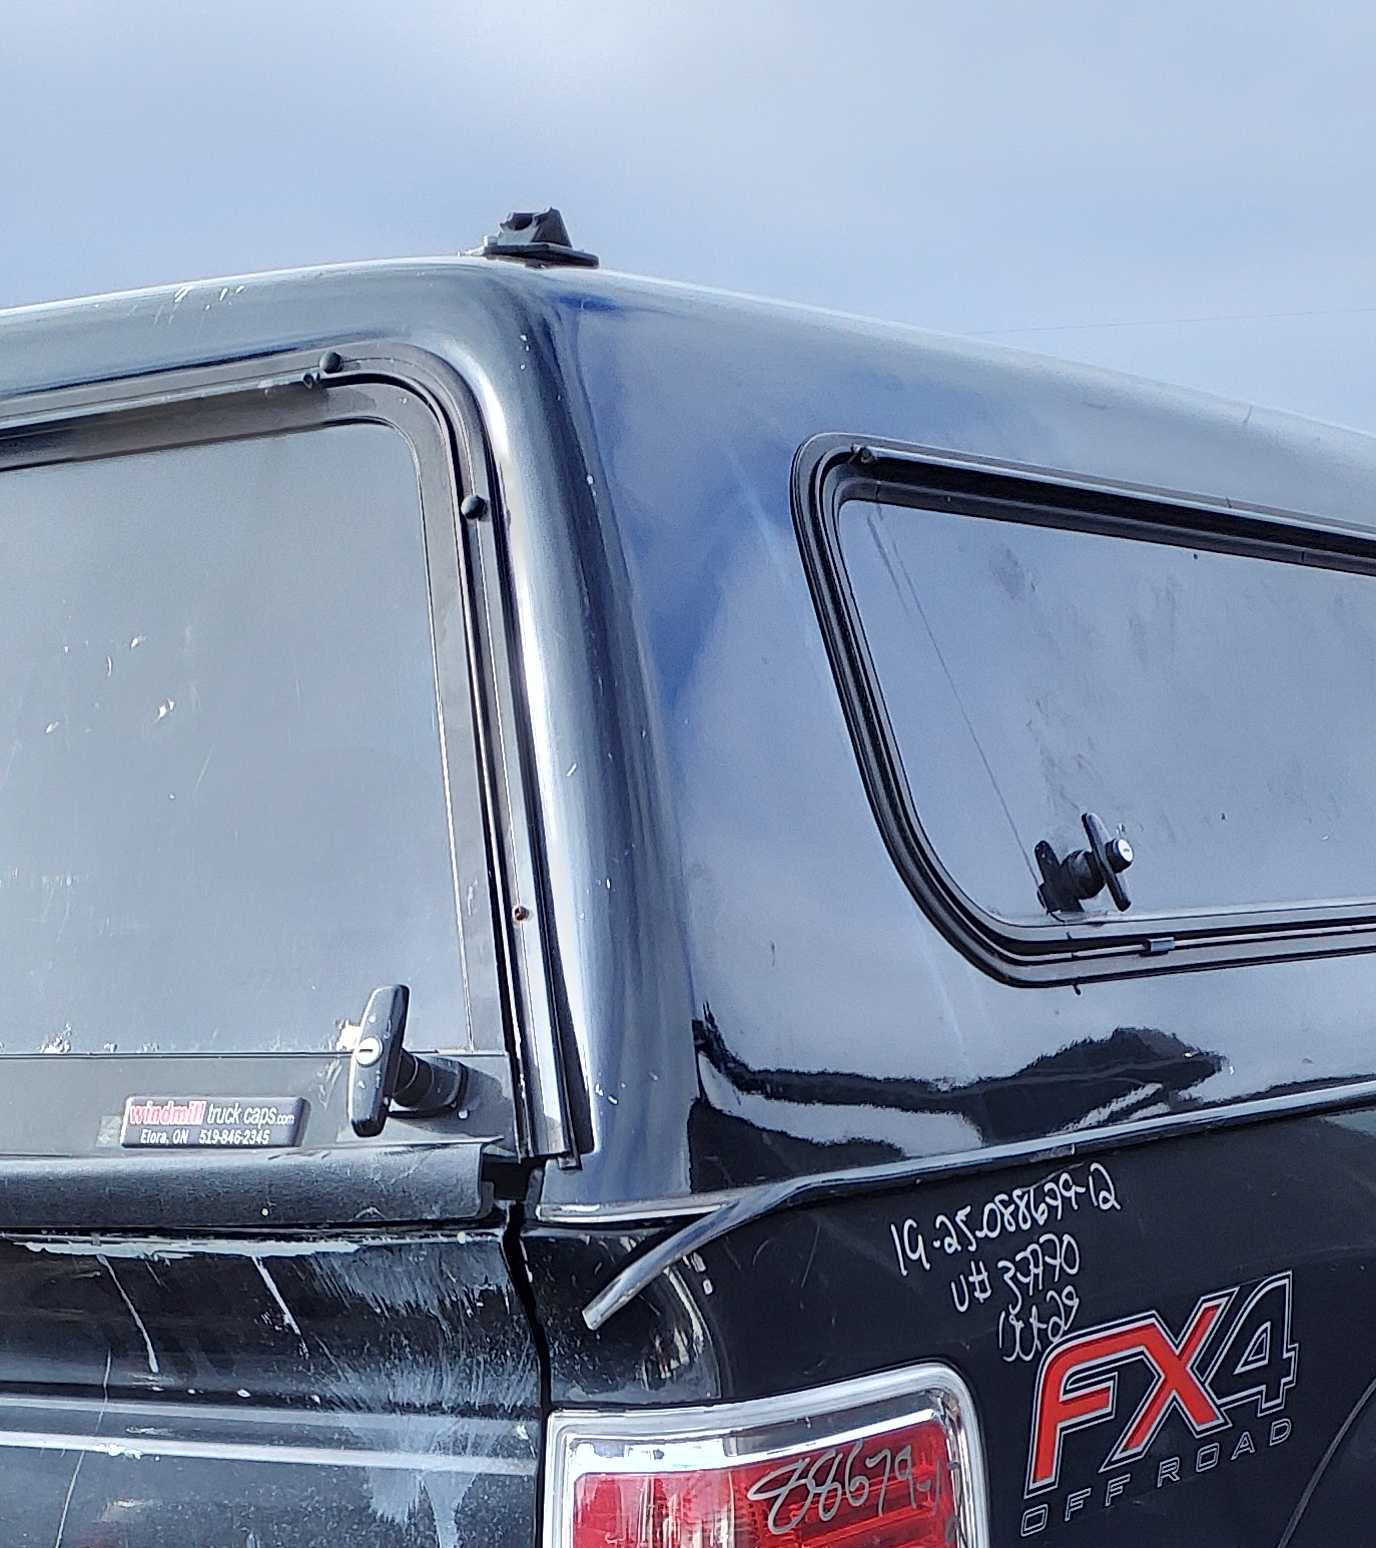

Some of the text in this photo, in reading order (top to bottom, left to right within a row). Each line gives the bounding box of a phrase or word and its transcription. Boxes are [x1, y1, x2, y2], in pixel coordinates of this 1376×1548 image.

[129, 1100, 295, 1129] windmill truck caps.com
[173, 1129, 189, 1144] ON
[199, 1130, 271, 1145] 519-846-2345
[1024, 1270, 1299, 1499] FX4
[1020, 1418, 1292, 1536] OFF ROAD
